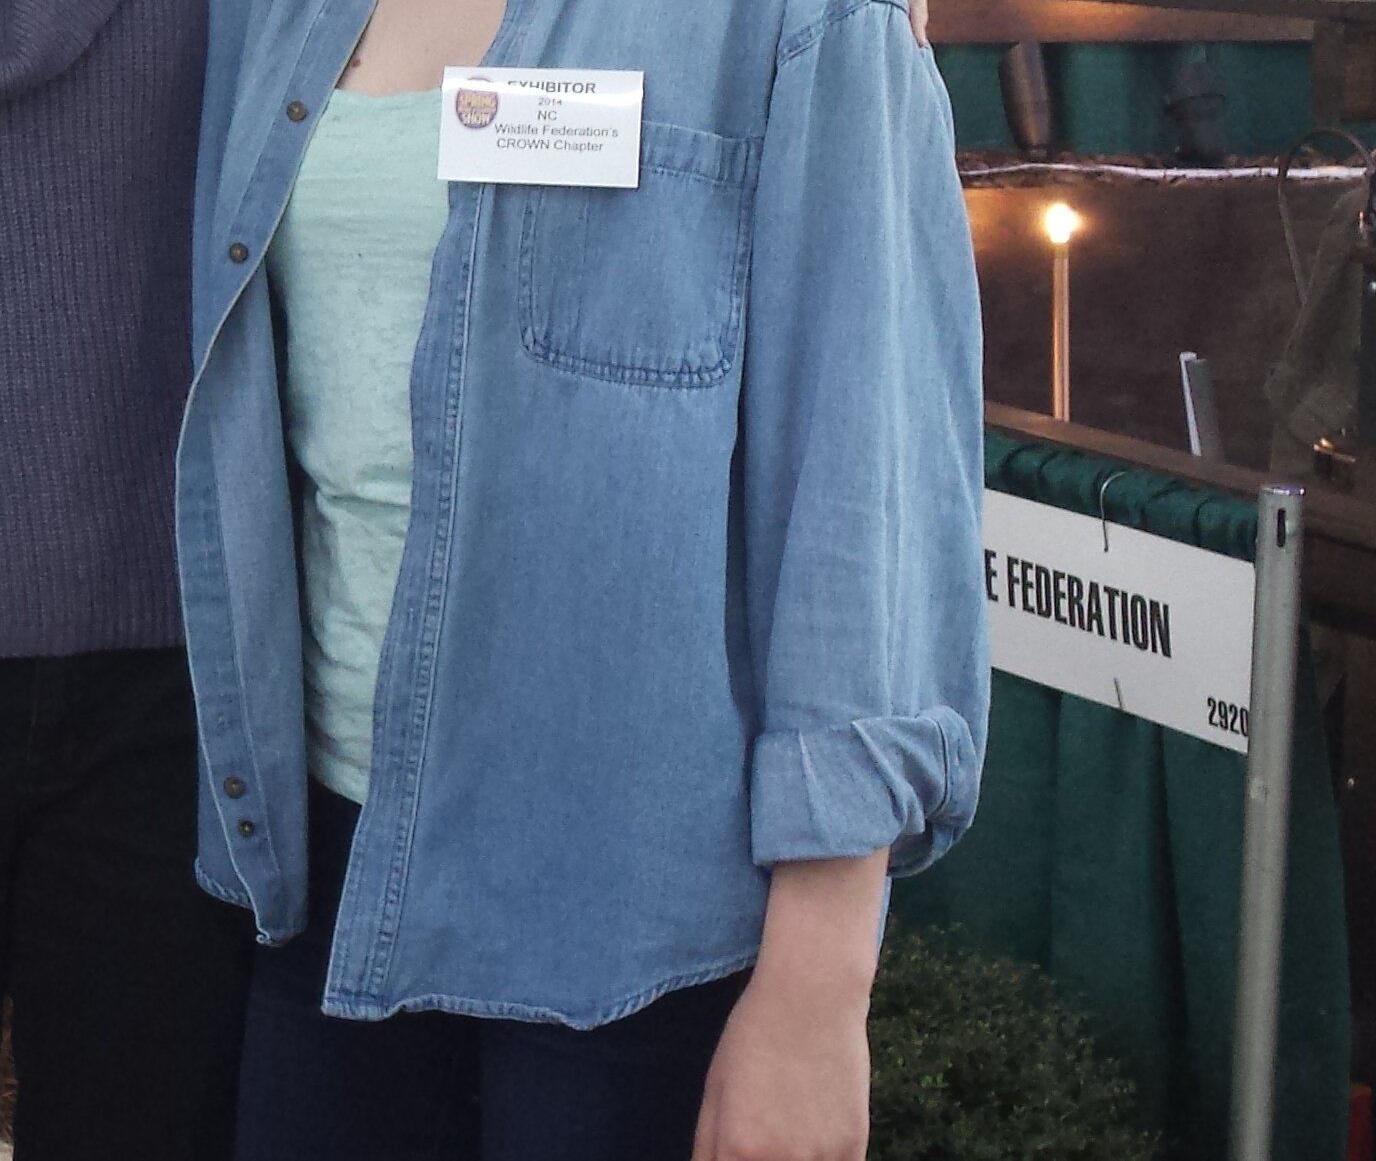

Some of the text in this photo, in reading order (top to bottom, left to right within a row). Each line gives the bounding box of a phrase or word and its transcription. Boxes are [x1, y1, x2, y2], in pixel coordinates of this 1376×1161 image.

[537, 110, 558, 121] NC
[494, 123, 539, 136] Wildlife
[496, 138, 604, 153] CROWN Chapter
[1005, 553, 1173, 659] FEDERATION
